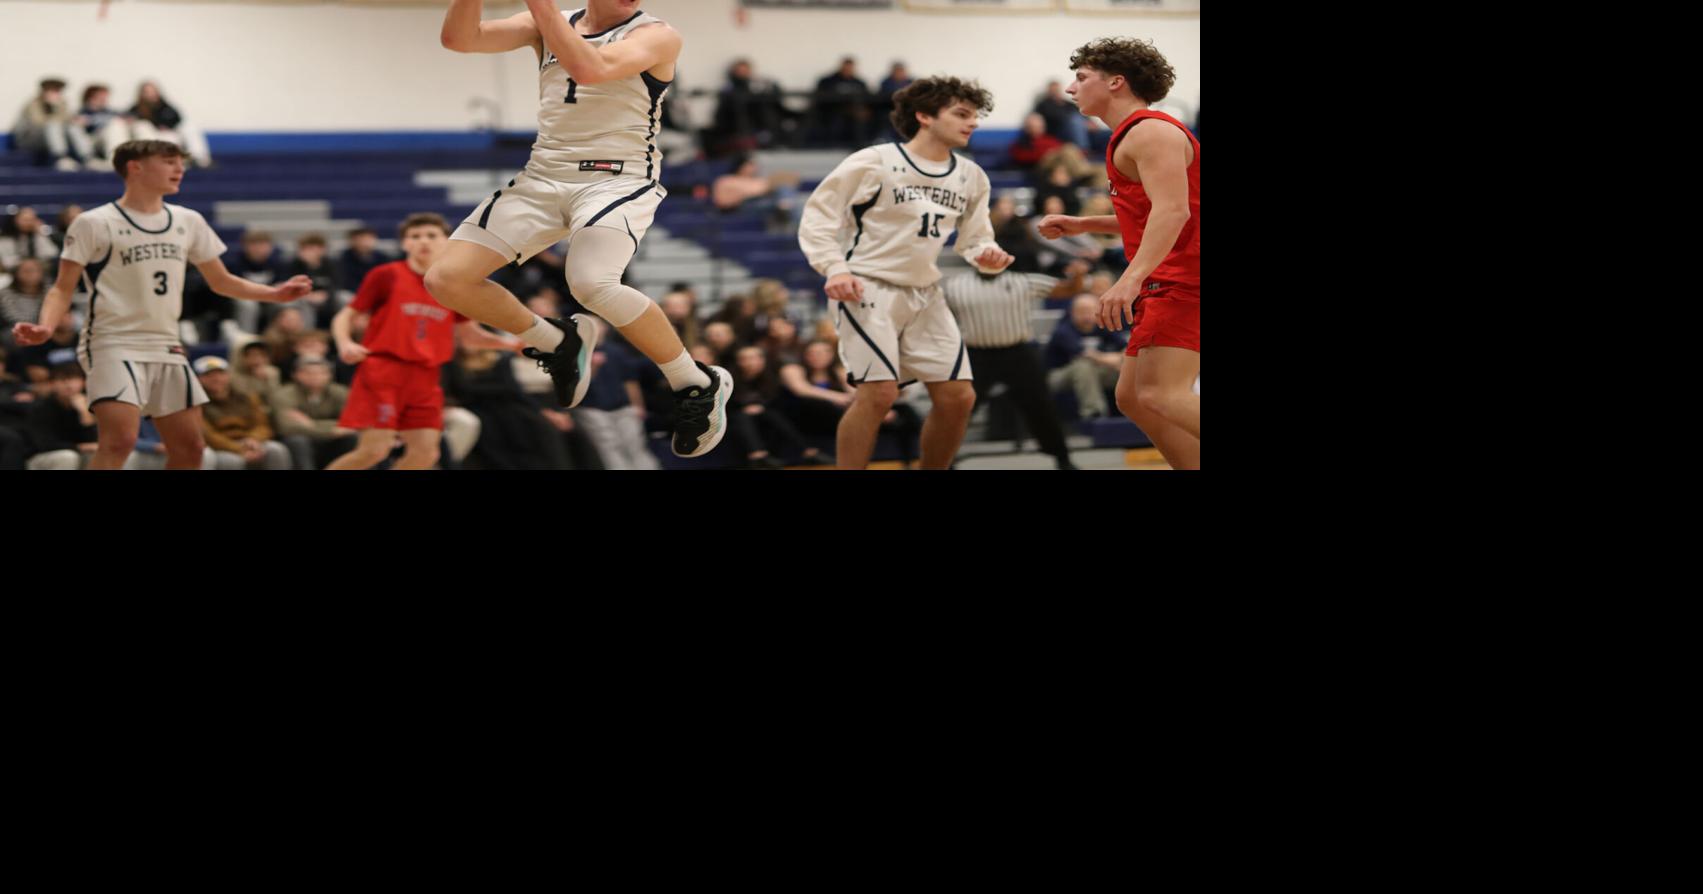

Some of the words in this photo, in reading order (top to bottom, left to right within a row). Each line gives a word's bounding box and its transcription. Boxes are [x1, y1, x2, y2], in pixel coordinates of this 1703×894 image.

[564, 77, 577, 103] 1
[893, 185, 966, 212] WESTERLY
[918, 212, 945, 238] 15
[153, 271, 168, 295] 3
